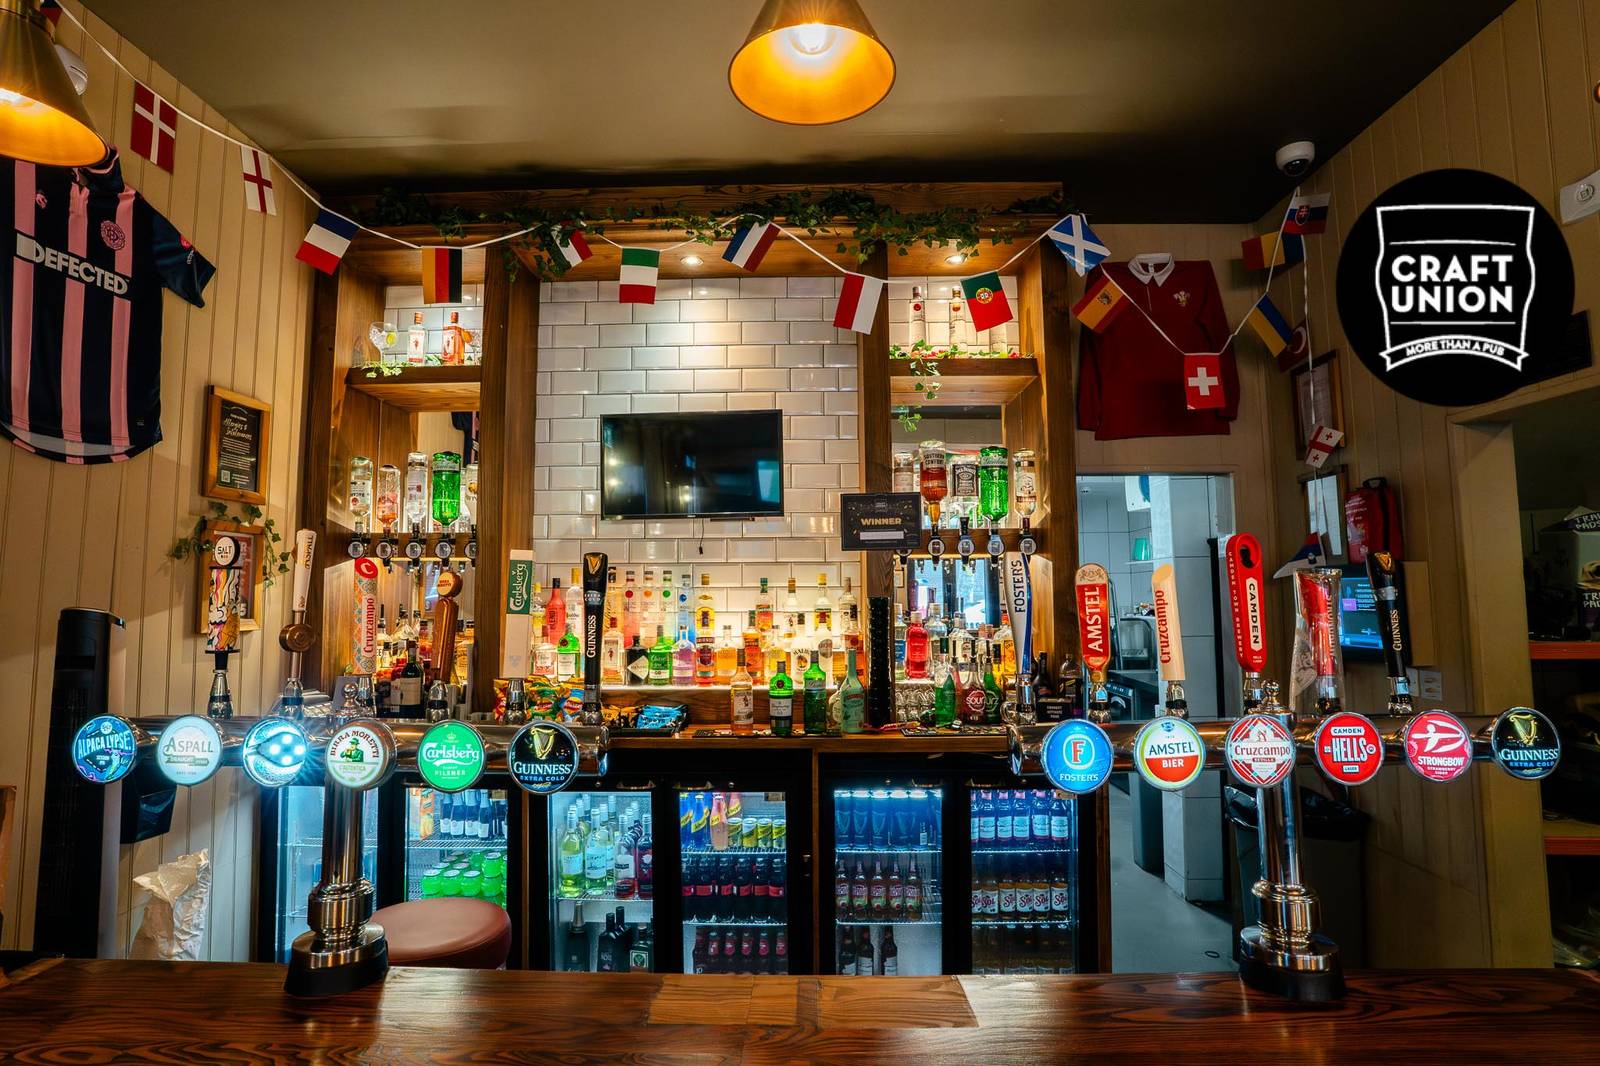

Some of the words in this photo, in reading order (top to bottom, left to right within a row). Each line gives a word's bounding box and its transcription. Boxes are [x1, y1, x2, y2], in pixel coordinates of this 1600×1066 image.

[16, 233, 129, 295] DEFECTED
[861, 518, 902, 526] WINNER
[1228, 551, 1237, 586] CAMDEN
[509, 563, 527, 611] Carlsberg
[1014, 559, 1026, 613] FOSTER'S
[363, 598, 376, 654] Cruzcampo
[1084, 586, 1103, 653] AMSTEL
[1248, 583, 1260, 644] CAMDEN
[586, 614, 597, 658] GUINNESS
[1154, 589, 1172, 664] Cruzcampo
[1390, 609, 1403, 651] GUINNESS
[163, 736, 214, 756] ASPALL
[330, 732, 350, 757] BIRRA
[351, 729, 380, 759] MORETTI
[422, 742, 481, 762] Carlsberg
[1072, 740, 1086, 763] F
[1149, 742, 1195, 756] AMSTEL
[1234, 744, 1291, 758] Cruzcampo
[1331, 737, 1368, 762] HELLS
[1501, 748, 1559, 762] GUINNESS
[513, 761, 572, 776] GUINNESS
[1162, 758, 1184, 768] BIER
[1417, 755, 1465, 767] STRONGBOW
[1059, 773, 1099, 782] FOSTER'S
